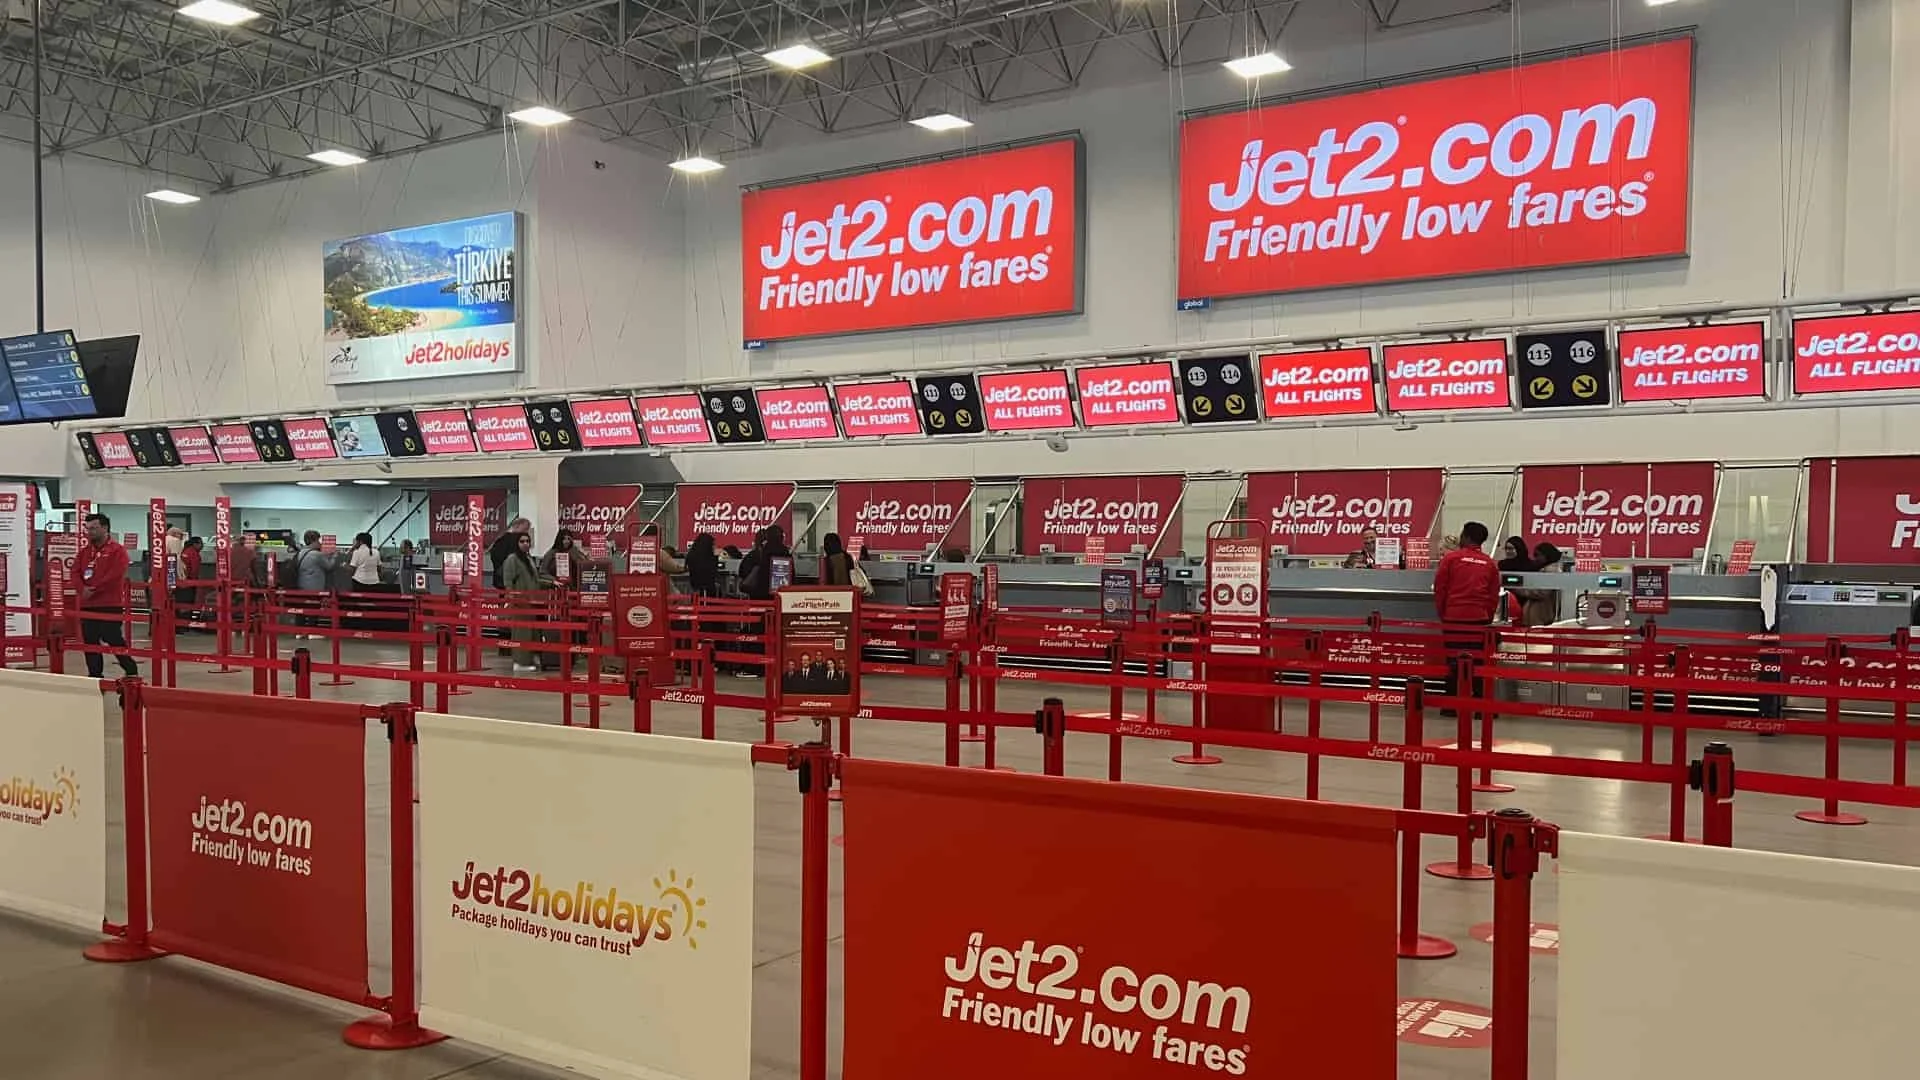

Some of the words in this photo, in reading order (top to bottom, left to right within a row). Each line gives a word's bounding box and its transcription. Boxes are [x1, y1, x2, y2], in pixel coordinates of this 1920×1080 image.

[1208, 97, 1656, 211] Jet2.com
[761, 186, 1052, 269] Jet2.com
[1204, 203, 1390, 263] Friendly
[1402, 196, 1491, 240] low
[1508, 178, 1648, 229] fares
[454, 244, 513, 285] TÜRKİYE
[760, 265, 883, 310] Friendly
[890, 261, 949, 297] low
[959, 250, 1050, 289] fares
[456, 283, 475, 306] THIS
[475, 281, 511, 305] SUMMER
[405, 337, 510, 365] Jet2holidays
[1570, 347, 1596, 358] 116
[1799, 332, 1920, 357] Jet2.co
[1527, 349, 1551, 360] 115
[1624, 343, 1759, 367] Jet2.com
[1221, 370, 1240, 380] 114
[1265, 365, 1369, 387] Jet2.com
[1389, 358, 1503, 379] Jet2.com
[1809, 362, 1847, 378] ALL
[1851, 357, 1920, 376] FLIGHT
[1634, 372, 1667, 387] ALL
[1672, 368, 1748, 384] FLIGHTS
[985, 385, 1067, 403] Jet2.com
[1082, 378, 1170, 398] Jet2.com
[1274, 390, 1299, 404] ALL
[1303, 387, 1362, 402] FLIGHTS
[1398, 384, 1426, 398] ALL
[1430, 381, 1495, 396] FLIGHTS
[763, 400, 829, 415] Jet2.com
[842, 395, 912, 411] Jet2.com
[994, 407, 1013, 419] ALL
[1016, 405, 1063, 417] FLIGHTS
[1092, 402, 1112, 414] ALL
[1115, 399, 1166, 412] FLIGHTS
[476, 415, 527, 430] Jet2.com
[577, 411, 633, 425] Jet2.com
[642, 407, 701, 421] Jet2.com
[851, 416, 866, 426] ALL
[869, 413, 910, 424] FLIGHTS
[421, 420, 467, 433] Jet2.com
[585, 429, 598, 438] ALL
[600, 427, 632, 437] FLIGHTS
[650, 426, 665, 434] ALL
[667, 423, 701, 433] FLIGHTS
[771, 420, 786, 430] ALL
[789, 417, 827, 428] FLIGHTS
[694, 502, 777, 521] Jet2.com
[856, 500, 952, 521] Jet2.com
[1044, 498, 1159, 520] Jet2.com
[1272, 494, 1413, 518] Jet2.com
[1532, 490, 1703, 517] Jet2.com
[80, 505, 89, 549] Jet2.c
[216, 502, 229, 549] Jet2.c
[481, 524, 500, 532] ares
[586, 521, 602, 532] low
[693, 523, 730, 535] Friendly
[732, 523, 749, 533] low
[751, 523, 769, 532] far
[855, 521, 898, 537] Friendly
[900, 522, 919, 534] low
[1043, 521, 1094, 537] Friendly
[1097, 521, 1120, 534] low
[1123, 521, 1157, 534] fares
[1271, 520, 1333, 537] Friendly
[1337, 520, 1363, 534] low
[1531, 518, 1606, 537] Friendly
[1610, 519, 1644, 534] low
[1650, 518, 1701, 535] fares
[152, 504, 163, 569] Jet2.com
[469, 501, 482, 576] Jet2.com
[1215, 544, 1257, 553] Jet2.com
[1002, 670, 1037, 679] Jet2.com
[1166, 681, 1207, 690] Jet2.com
[662, 690, 705, 703] Jet2.com
[1116, 722, 1172, 736] Jet2.com
[1368, 746, 1436, 762] Jet2.com
[0, 777, 64, 820] olidays
[12, 813, 24, 823] can
[24, 813, 43, 826] trust
[192, 796, 312, 849] Jet2.com
[191, 833, 245, 866] Friendly
[247, 843, 271, 867] low
[275, 848, 312, 876] fares
[452, 861, 673, 948] Jet2holidays
[452, 904, 498, 929] Package
[500, 915, 548, 939] holidays
[549, 929, 572, 943] you
[574, 933, 598, 948] can
[600, 935, 632, 956] trust
[944, 931, 1251, 1034] Jet2.com
[942, 986, 1074, 1046] Friendly
[1080, 1011, 1142, 1054] low
[1152, 1026, 1247, 1076] fares
